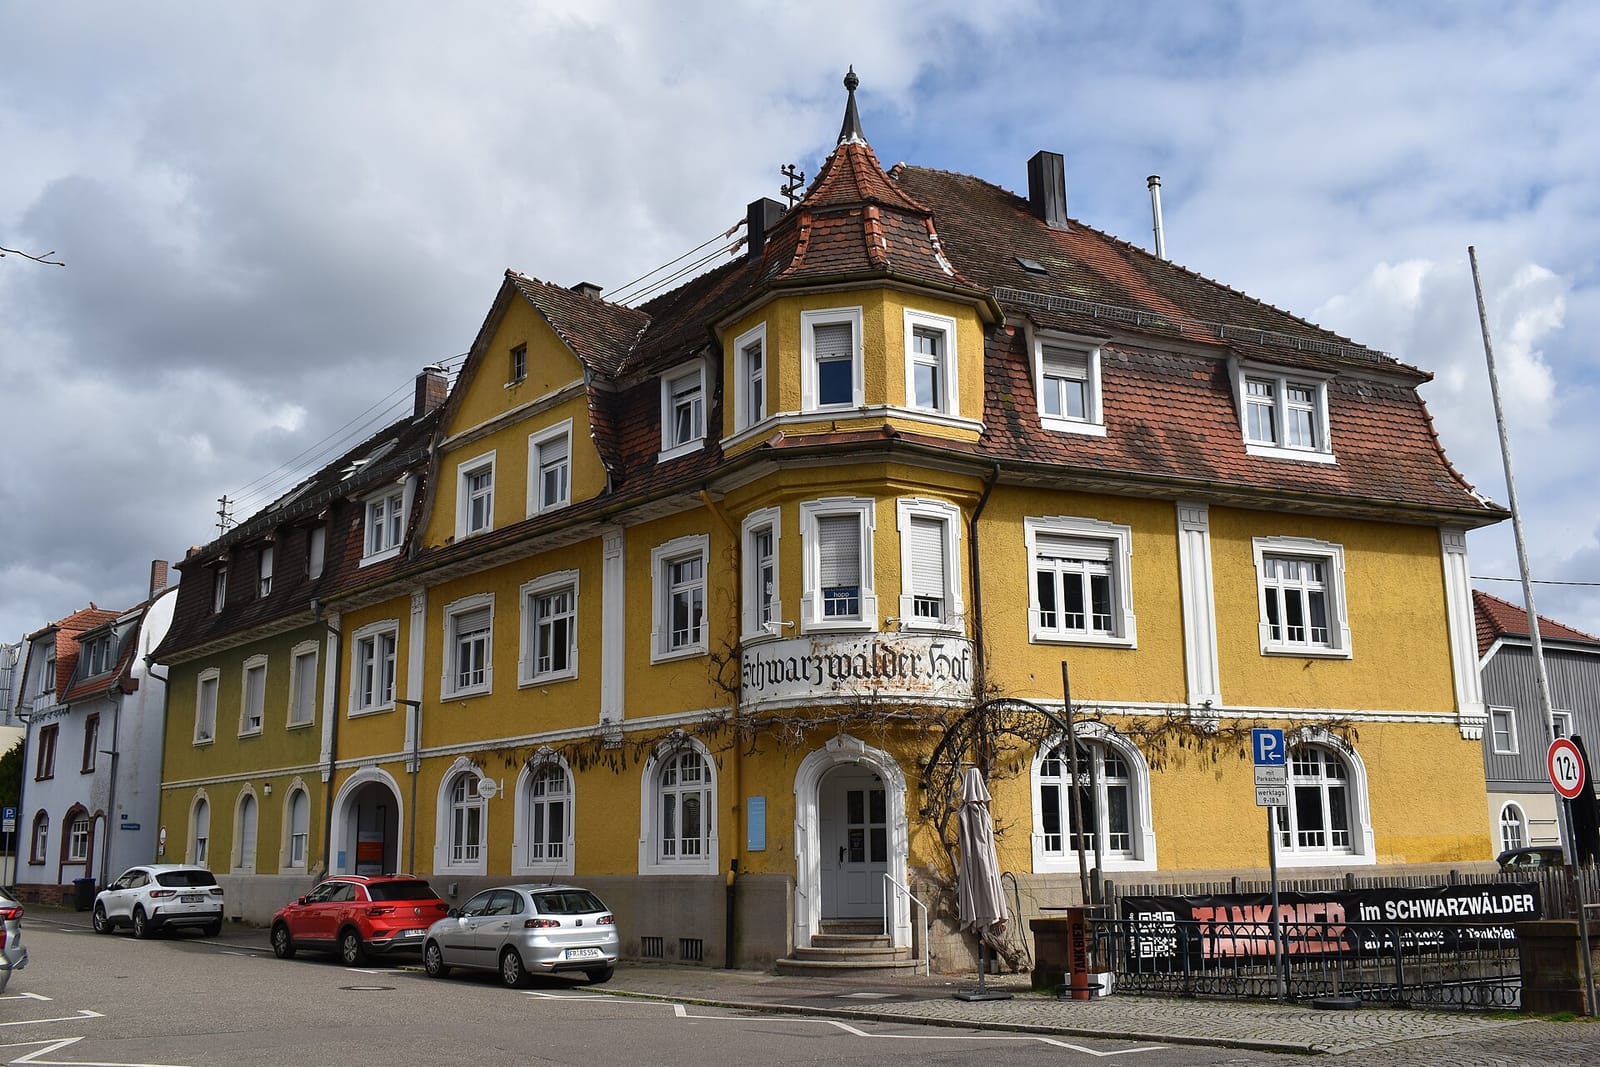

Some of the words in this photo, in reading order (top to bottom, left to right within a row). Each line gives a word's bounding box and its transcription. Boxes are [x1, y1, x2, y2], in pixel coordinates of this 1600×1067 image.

[742, 643, 923, 691] Schwarzwälder
[926, 643, 971, 683] Hof
[1259, 733, 1277, 761] P
[1258, 788, 1285, 797] werktags
[1359, 902, 1381, 921] im
[1385, 892, 1535, 920] SCHWARZWÄLDER
[1072, 923, 1086, 974] TANKBIER
[1191, 902, 1350, 959] TANKBIER
